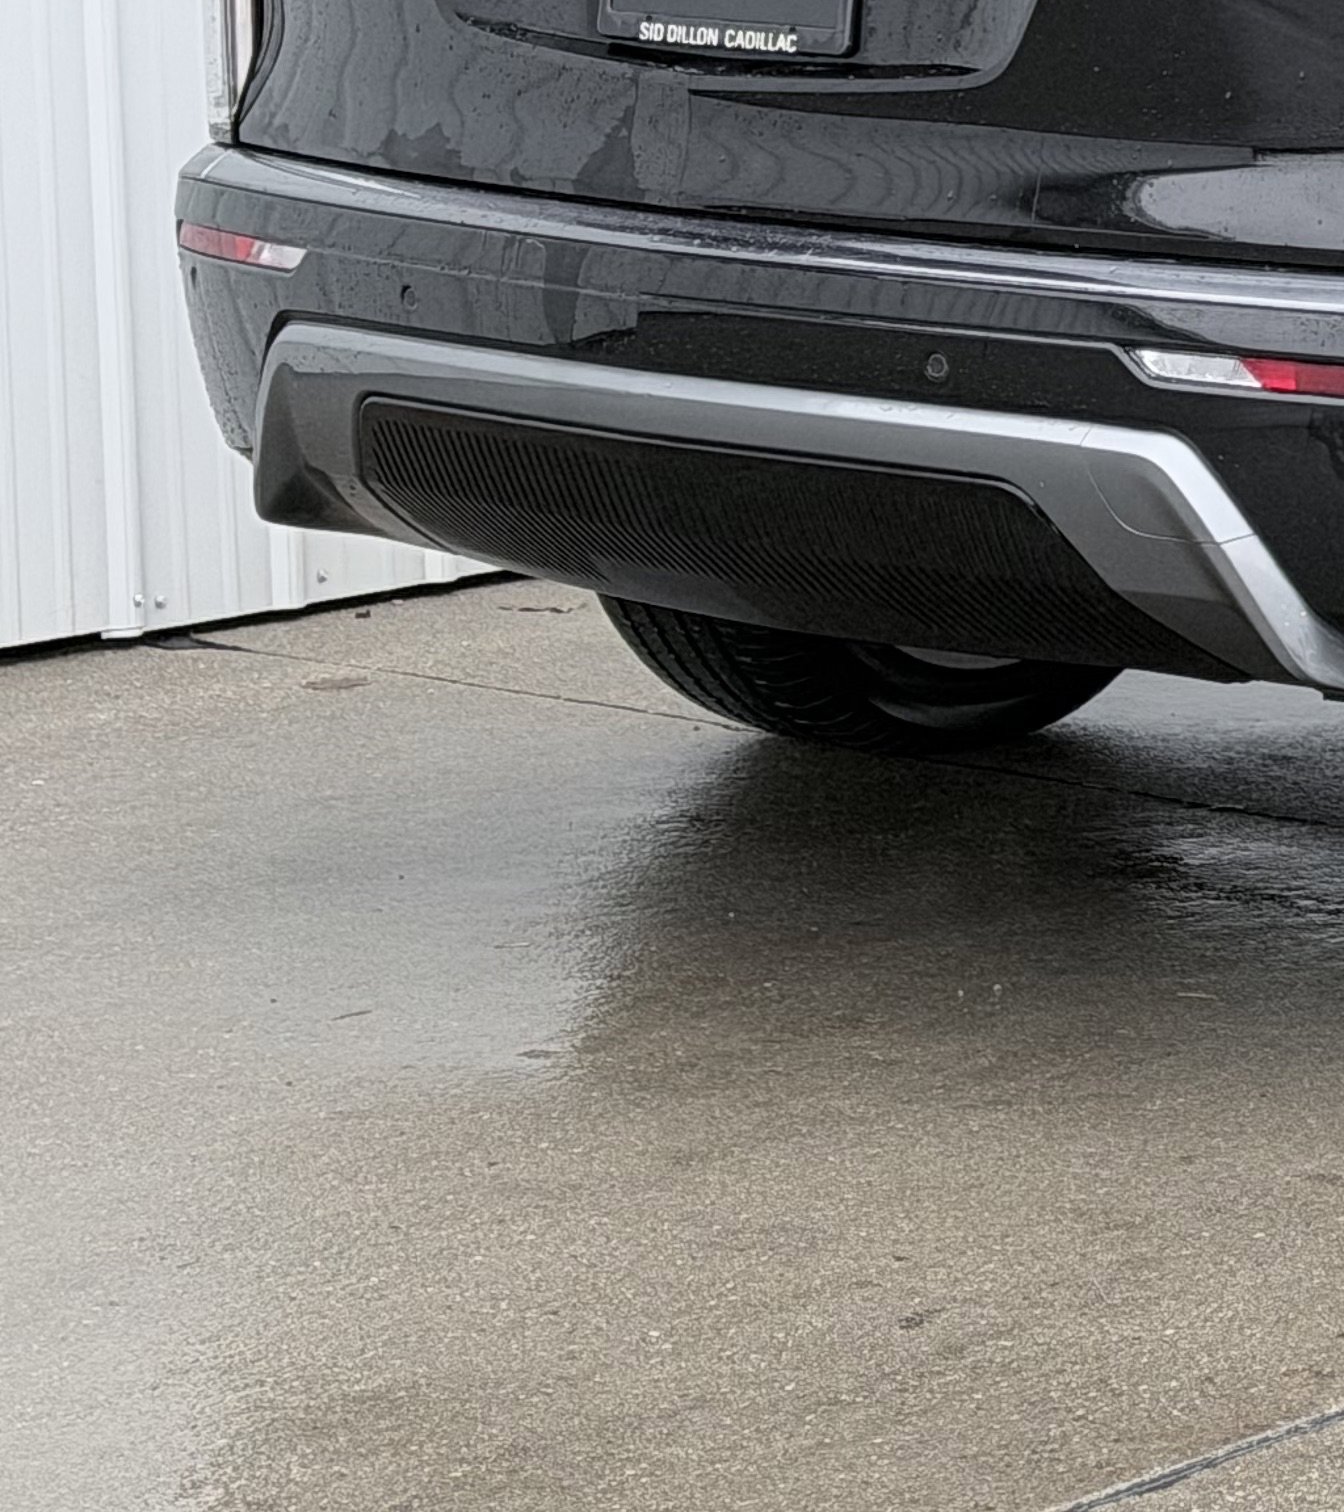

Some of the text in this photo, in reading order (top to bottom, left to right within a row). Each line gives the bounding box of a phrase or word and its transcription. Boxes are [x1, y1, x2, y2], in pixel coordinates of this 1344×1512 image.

[638, 22, 797, 53] SID DILLON CADILLAC
